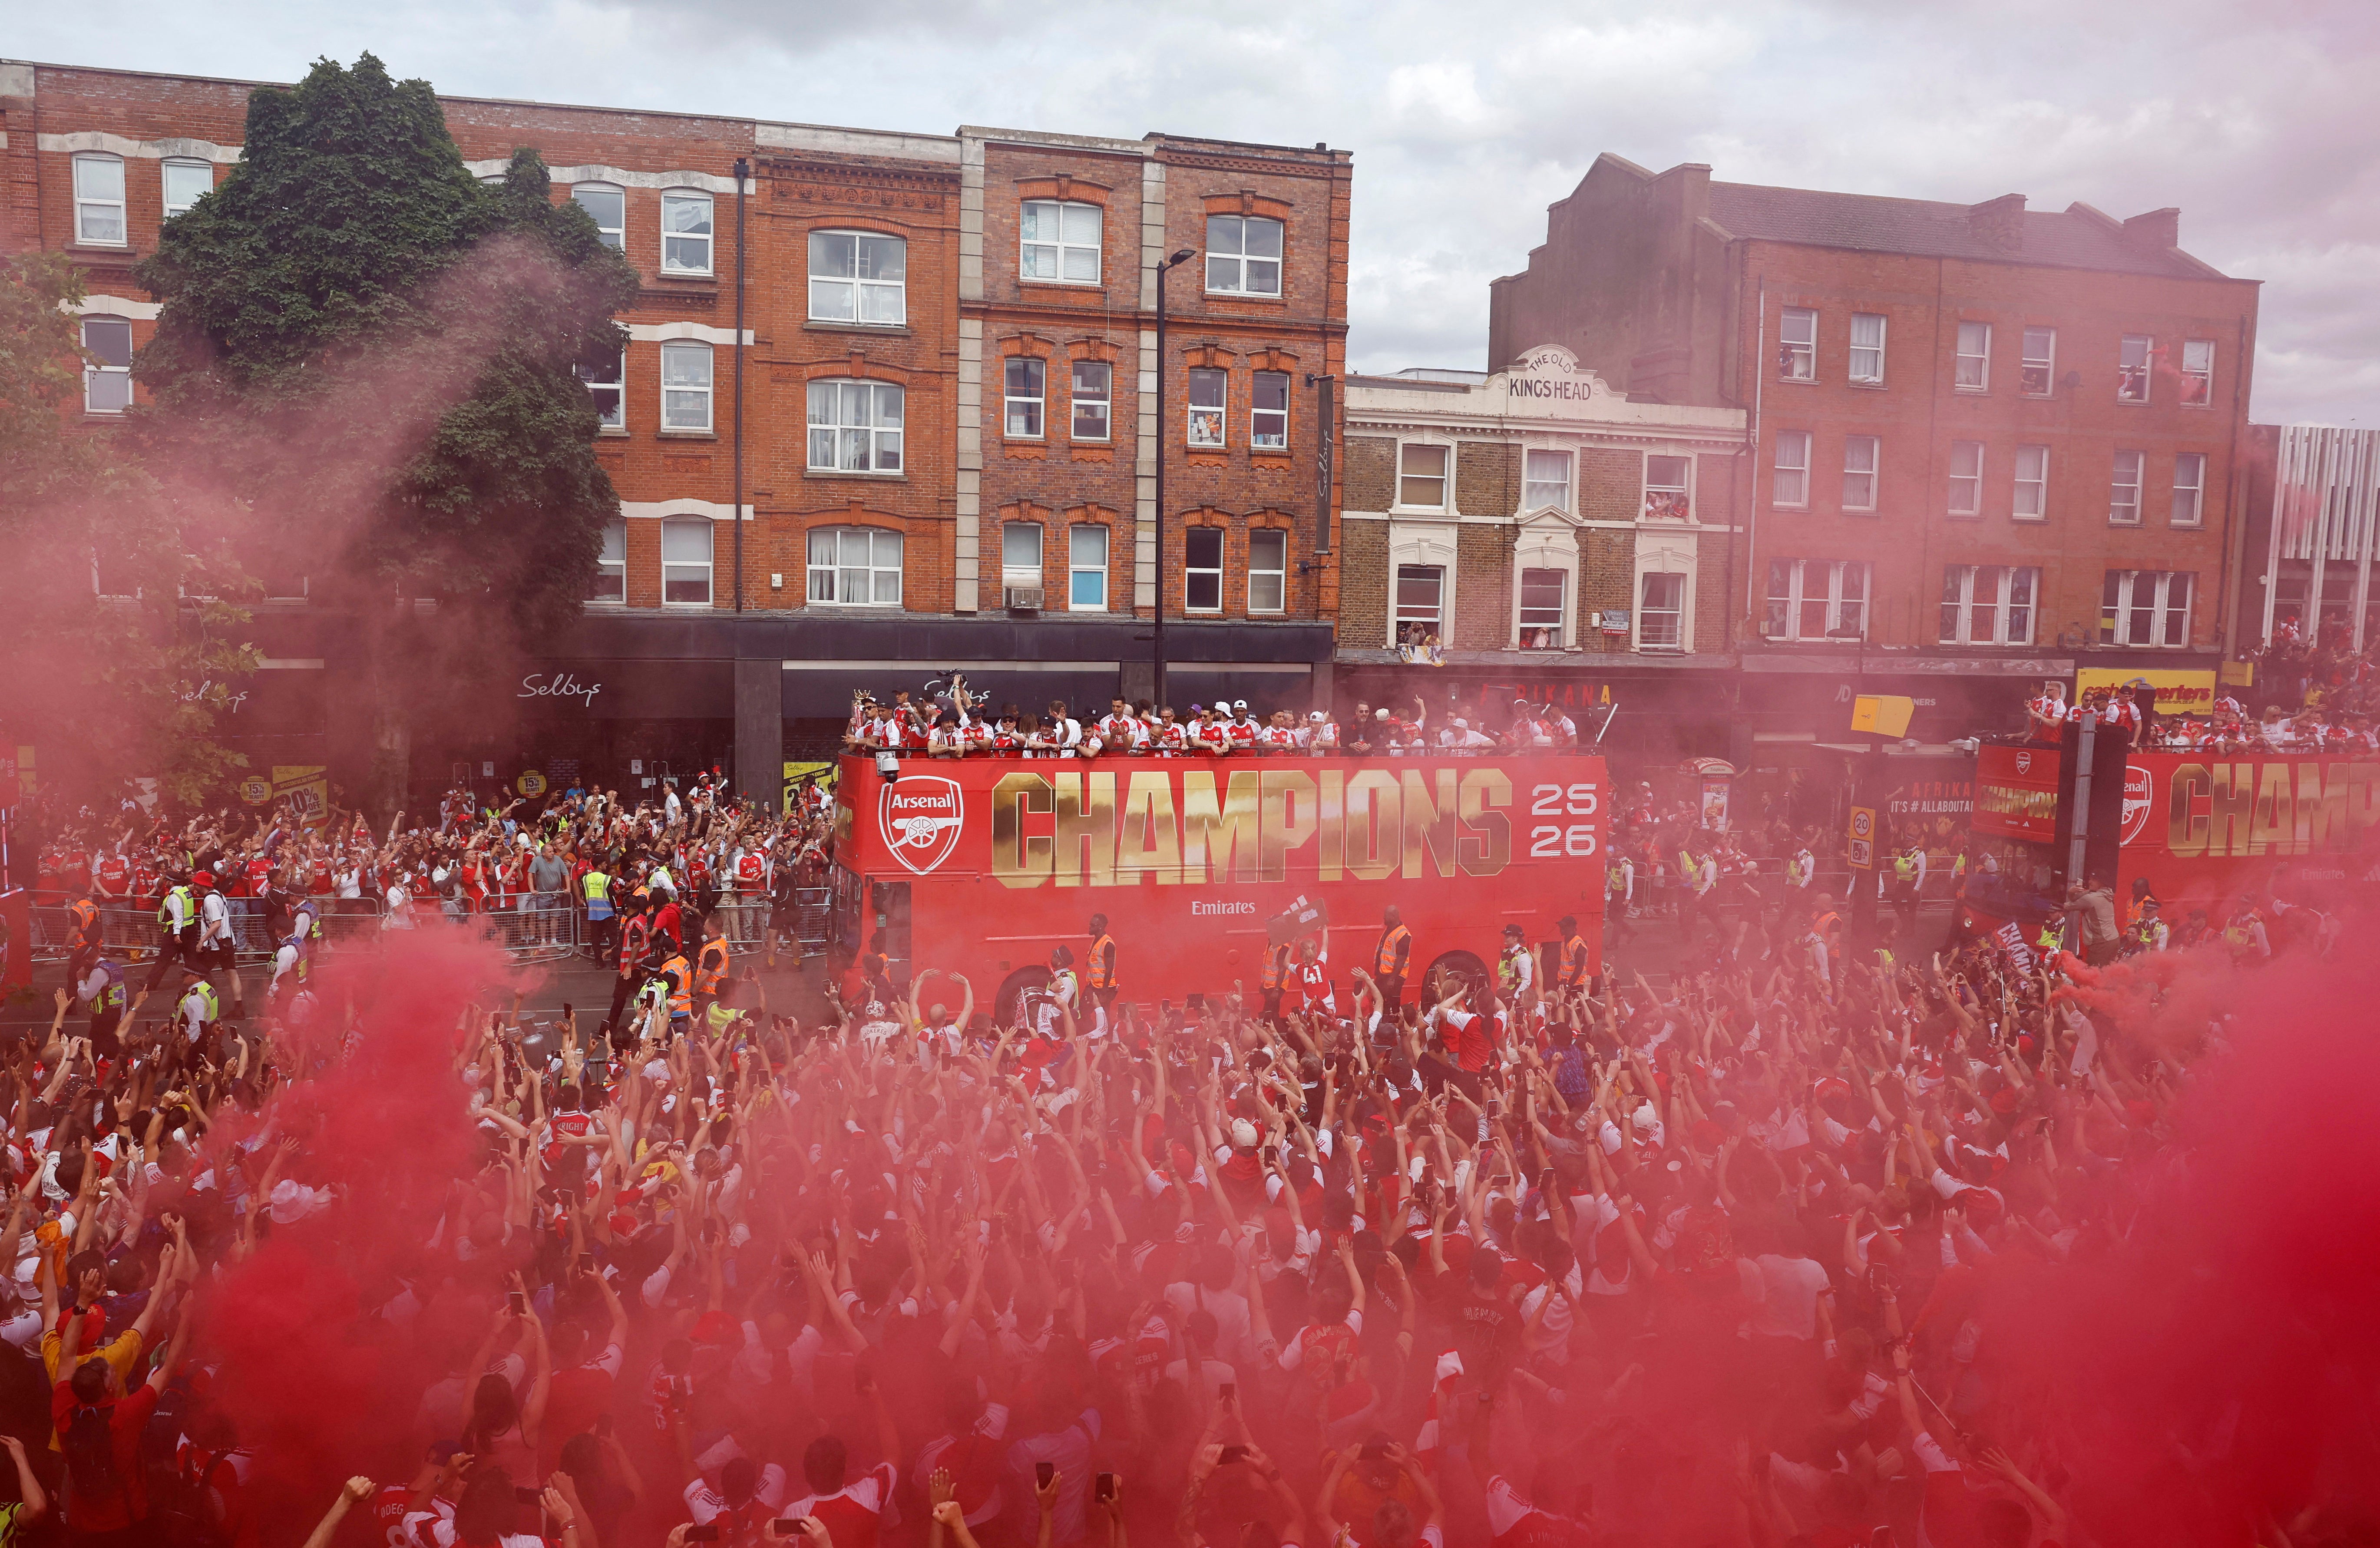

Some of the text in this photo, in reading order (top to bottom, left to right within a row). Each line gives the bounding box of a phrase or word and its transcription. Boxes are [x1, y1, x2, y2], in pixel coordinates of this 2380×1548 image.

[1529, 354, 1571, 373] THE OLD
[1554, 382, 1591, 400] HEAD
[1318, 429, 1332, 502] Selbys
[169, 680, 249, 714] elys
[517, 673, 602, 708] Selbys
[1479, 683, 1610, 707] ARIKANA
[1835, 684, 1851, 702] JD
[1912, 698, 1936, 706] NERS
[308, 774, 320, 782] EVENT
[789, 773, 815, 784] SPECTACAR
[2124, 780, 2145, 792] enal
[1912, 781, 1970, 798] AFRIKA
[308, 802, 321, 810] OFF
[891, 794, 952, 810] Arsenal
[1531, 783, 1597, 816] 25
[1891, 800, 1907, 813] IT'S
[1980, 785, 2058, 820] CHAMPION
[991, 768, 1512, 889] CHAMPIONS
[1856, 818, 1868, 830] 20
[1530, 825, 1596, 857] 26
[2302, 868, 2346, 880] Emirates
[1191, 900, 1256, 915] Emirates
[1303, 964, 1323, 985] 41
[557, 1122, 584, 1131] WRIGHT
[1464, 1307, 1505, 1326] HENRY
[380, 1503, 404, 1519] ØDEG
